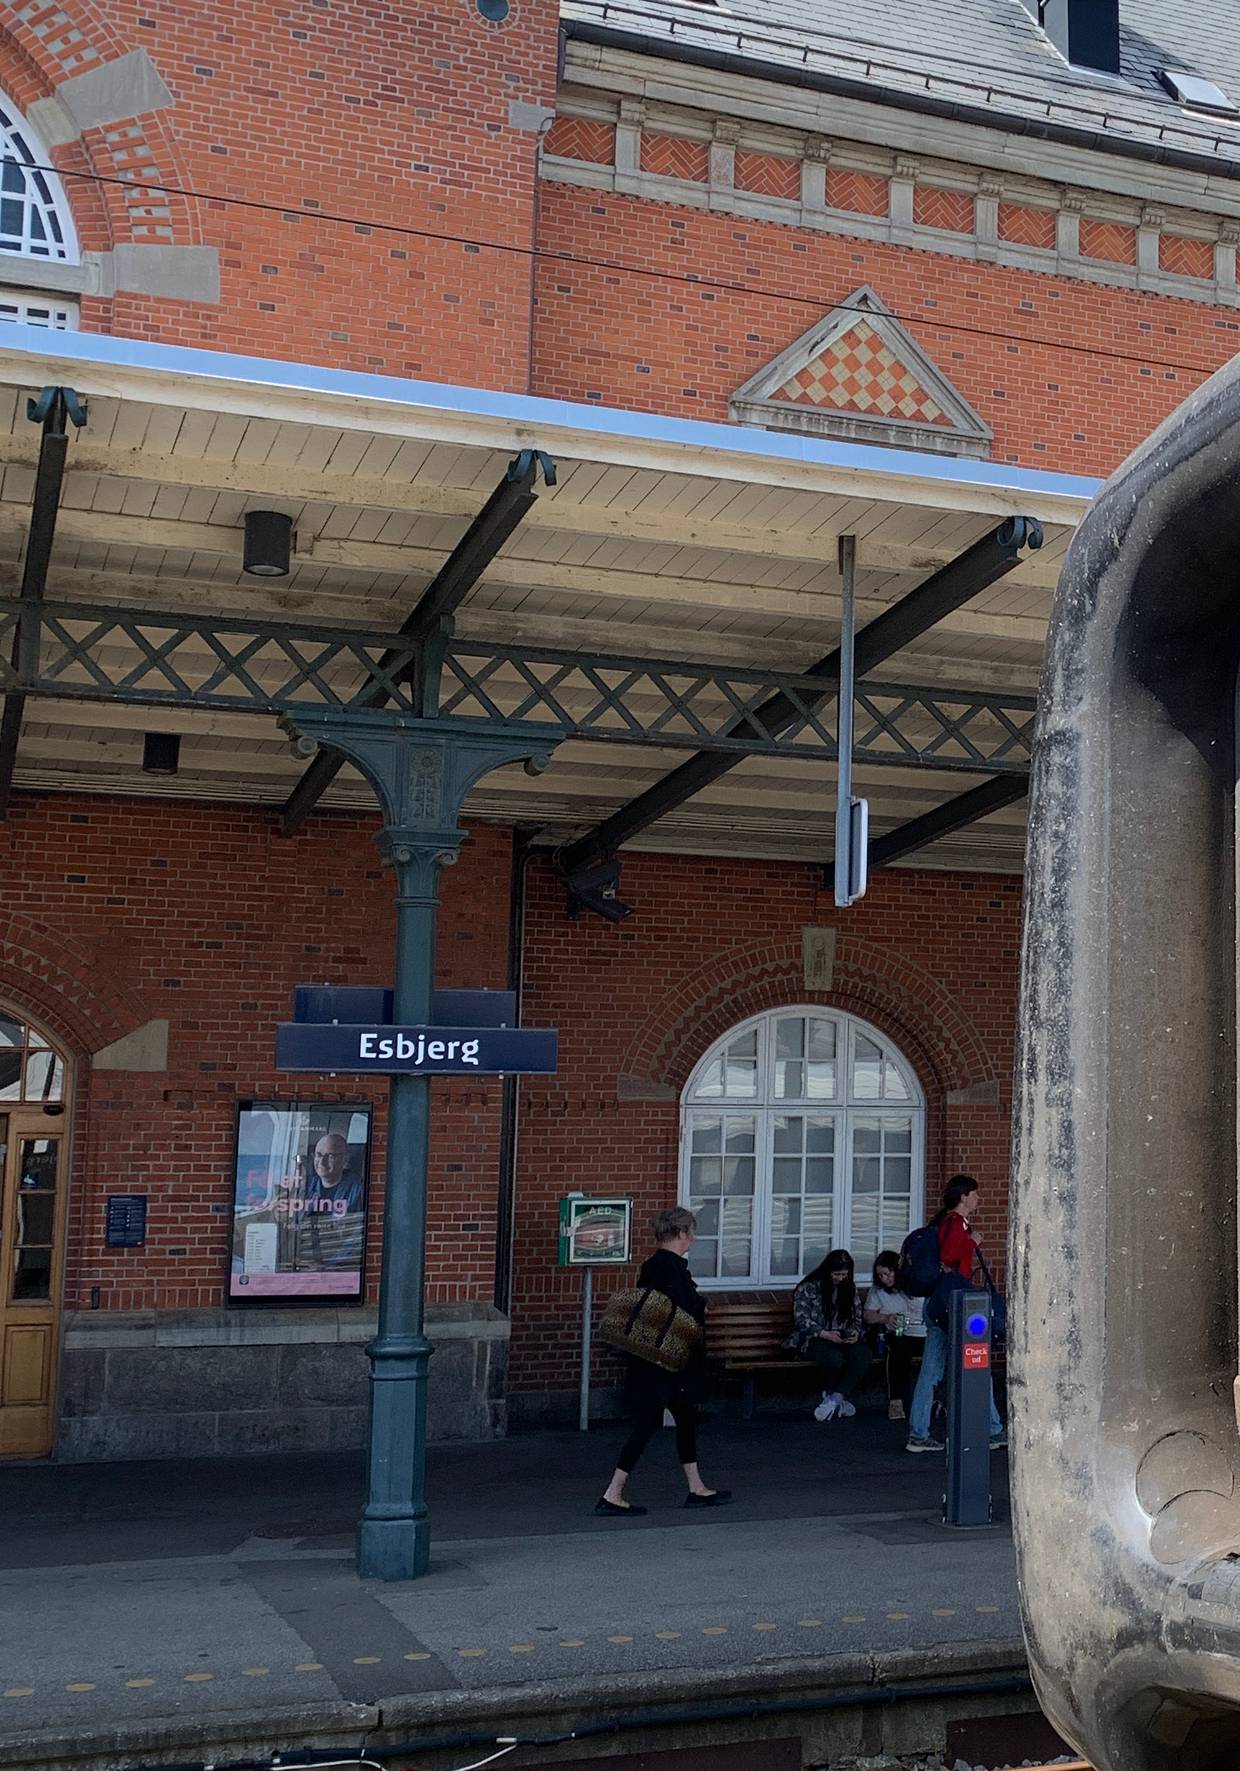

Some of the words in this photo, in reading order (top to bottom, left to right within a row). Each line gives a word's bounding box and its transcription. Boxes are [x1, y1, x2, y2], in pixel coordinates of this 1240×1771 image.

[359, 1033, 480, 1065] Esbjerg
[589, 1206, 612, 1215] AED
[965, 1347, 988, 1356] Check
